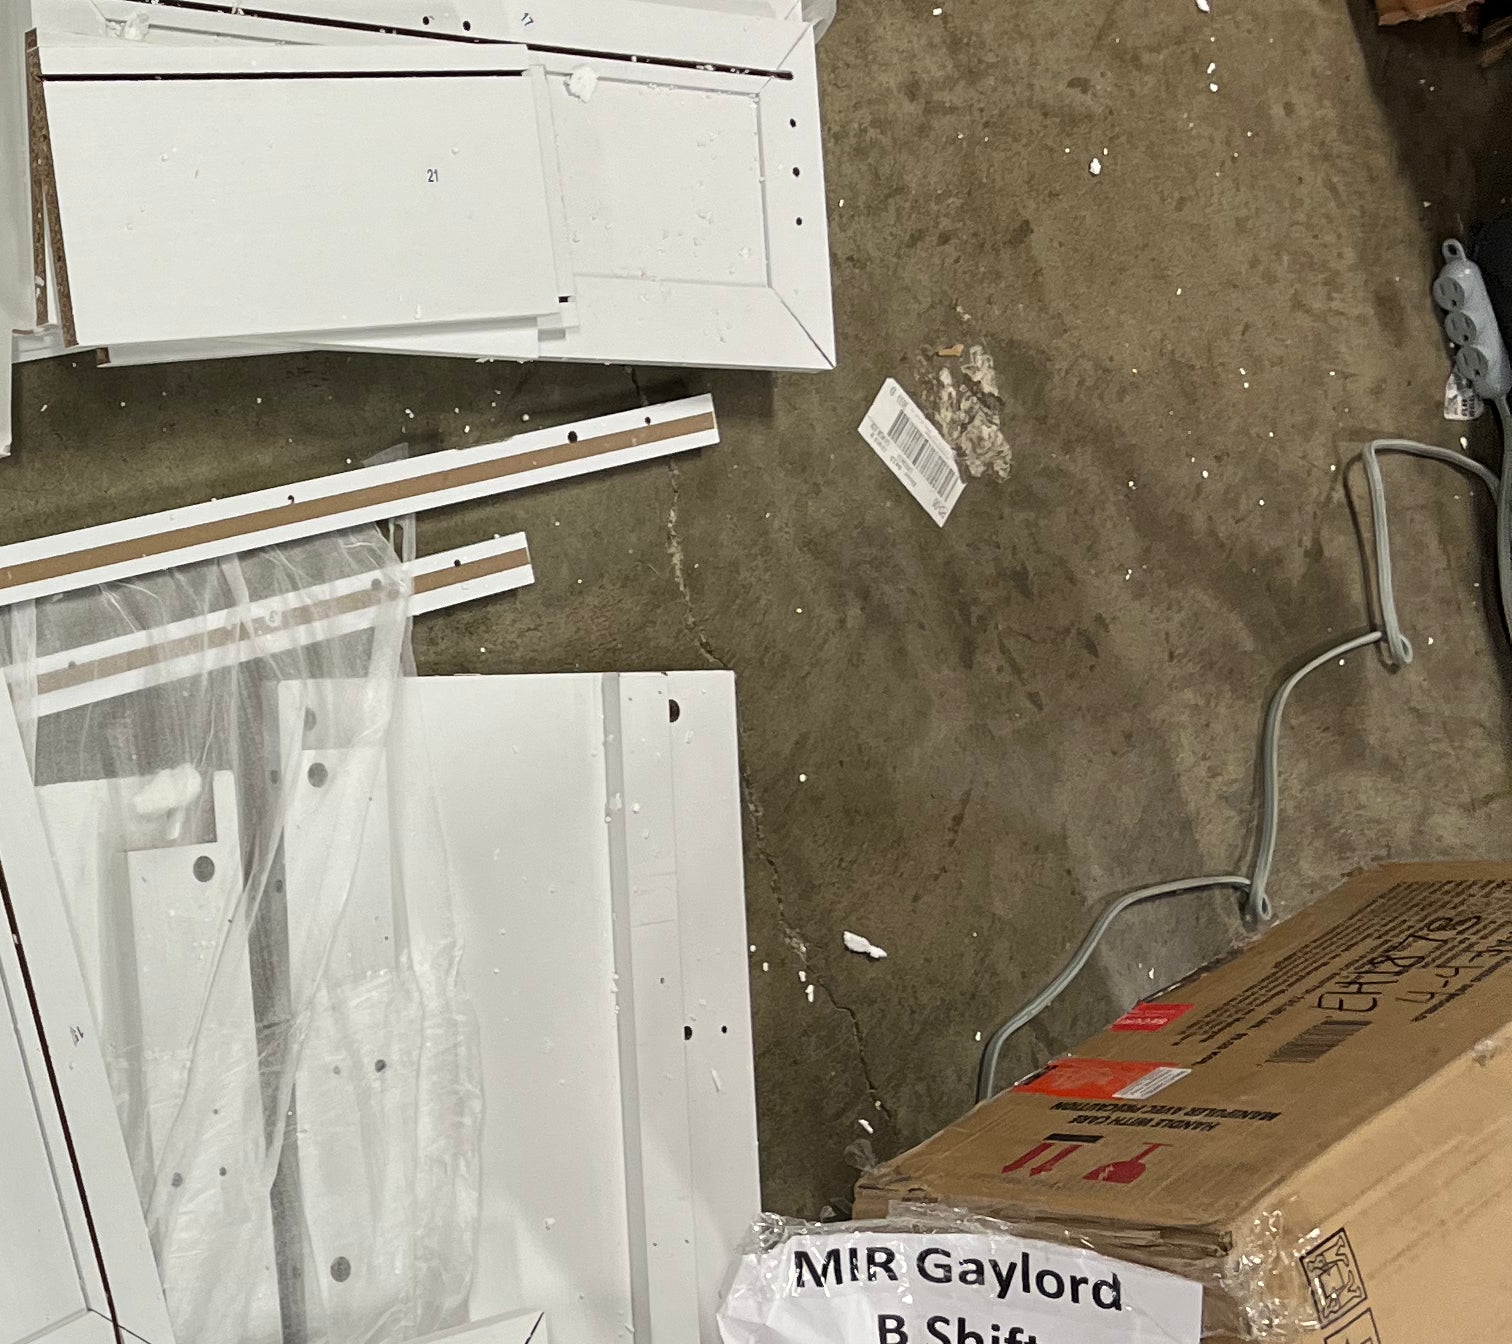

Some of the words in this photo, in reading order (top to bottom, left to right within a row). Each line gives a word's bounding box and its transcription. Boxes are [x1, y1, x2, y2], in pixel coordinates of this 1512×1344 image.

[427, 169, 439, 183] 21
[793, 1246, 898, 1288] MIR
[916, 1247, 1122, 1311] Gaylord
